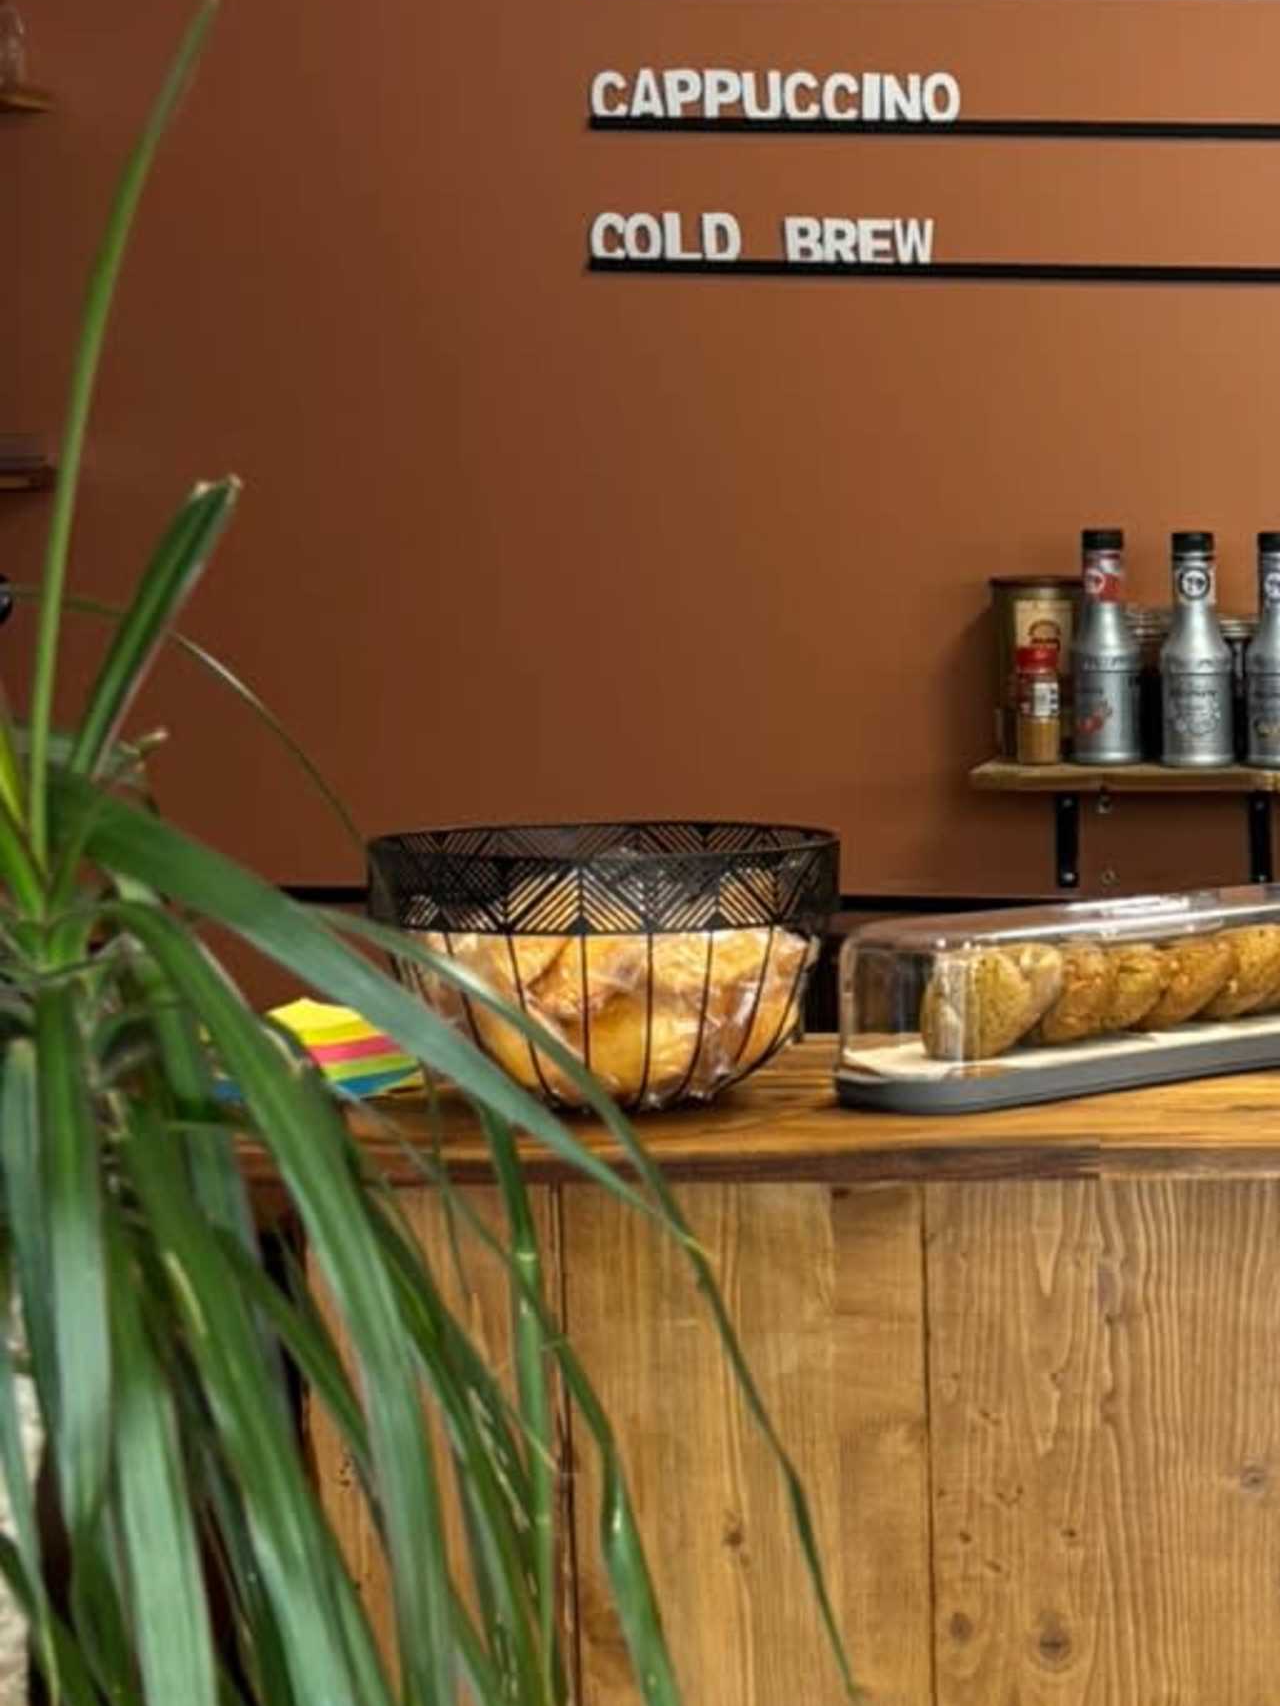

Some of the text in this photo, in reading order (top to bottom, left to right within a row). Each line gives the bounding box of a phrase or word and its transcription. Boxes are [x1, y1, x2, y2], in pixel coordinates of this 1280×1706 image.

[592, 69, 960, 121] CAPPUCCINO
[592, 213, 741, 260] COLD
[785, 218, 932, 264] BREW
